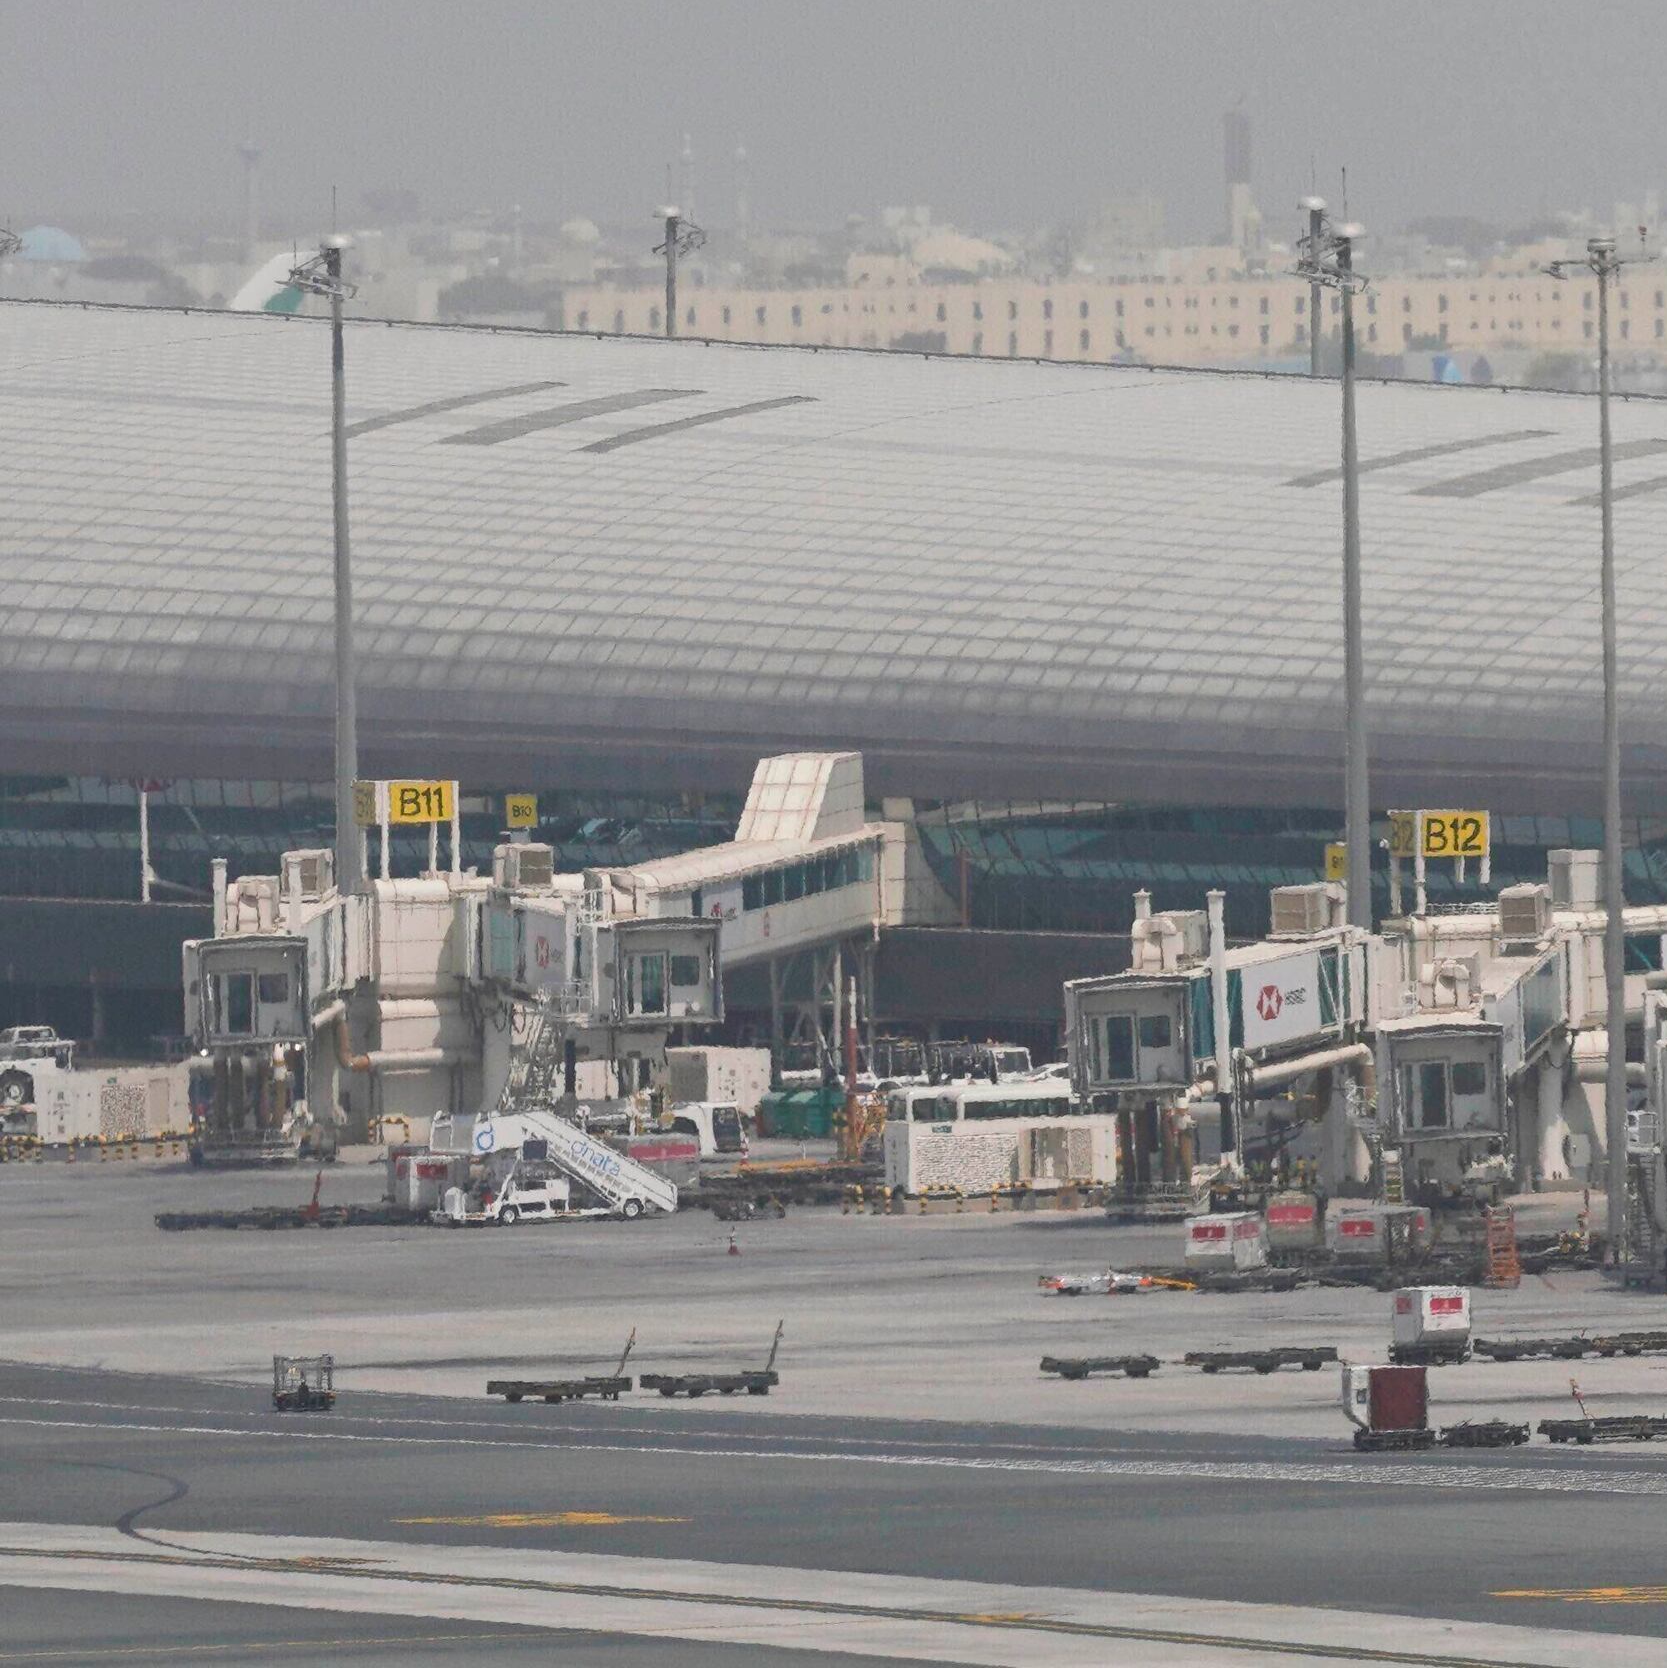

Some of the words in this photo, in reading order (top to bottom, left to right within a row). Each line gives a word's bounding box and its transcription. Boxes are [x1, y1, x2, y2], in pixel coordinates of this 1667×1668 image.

[400, 787, 444, 817] B11
[512, 804, 532, 818] B10
[1425, 817, 1481, 851] B12
